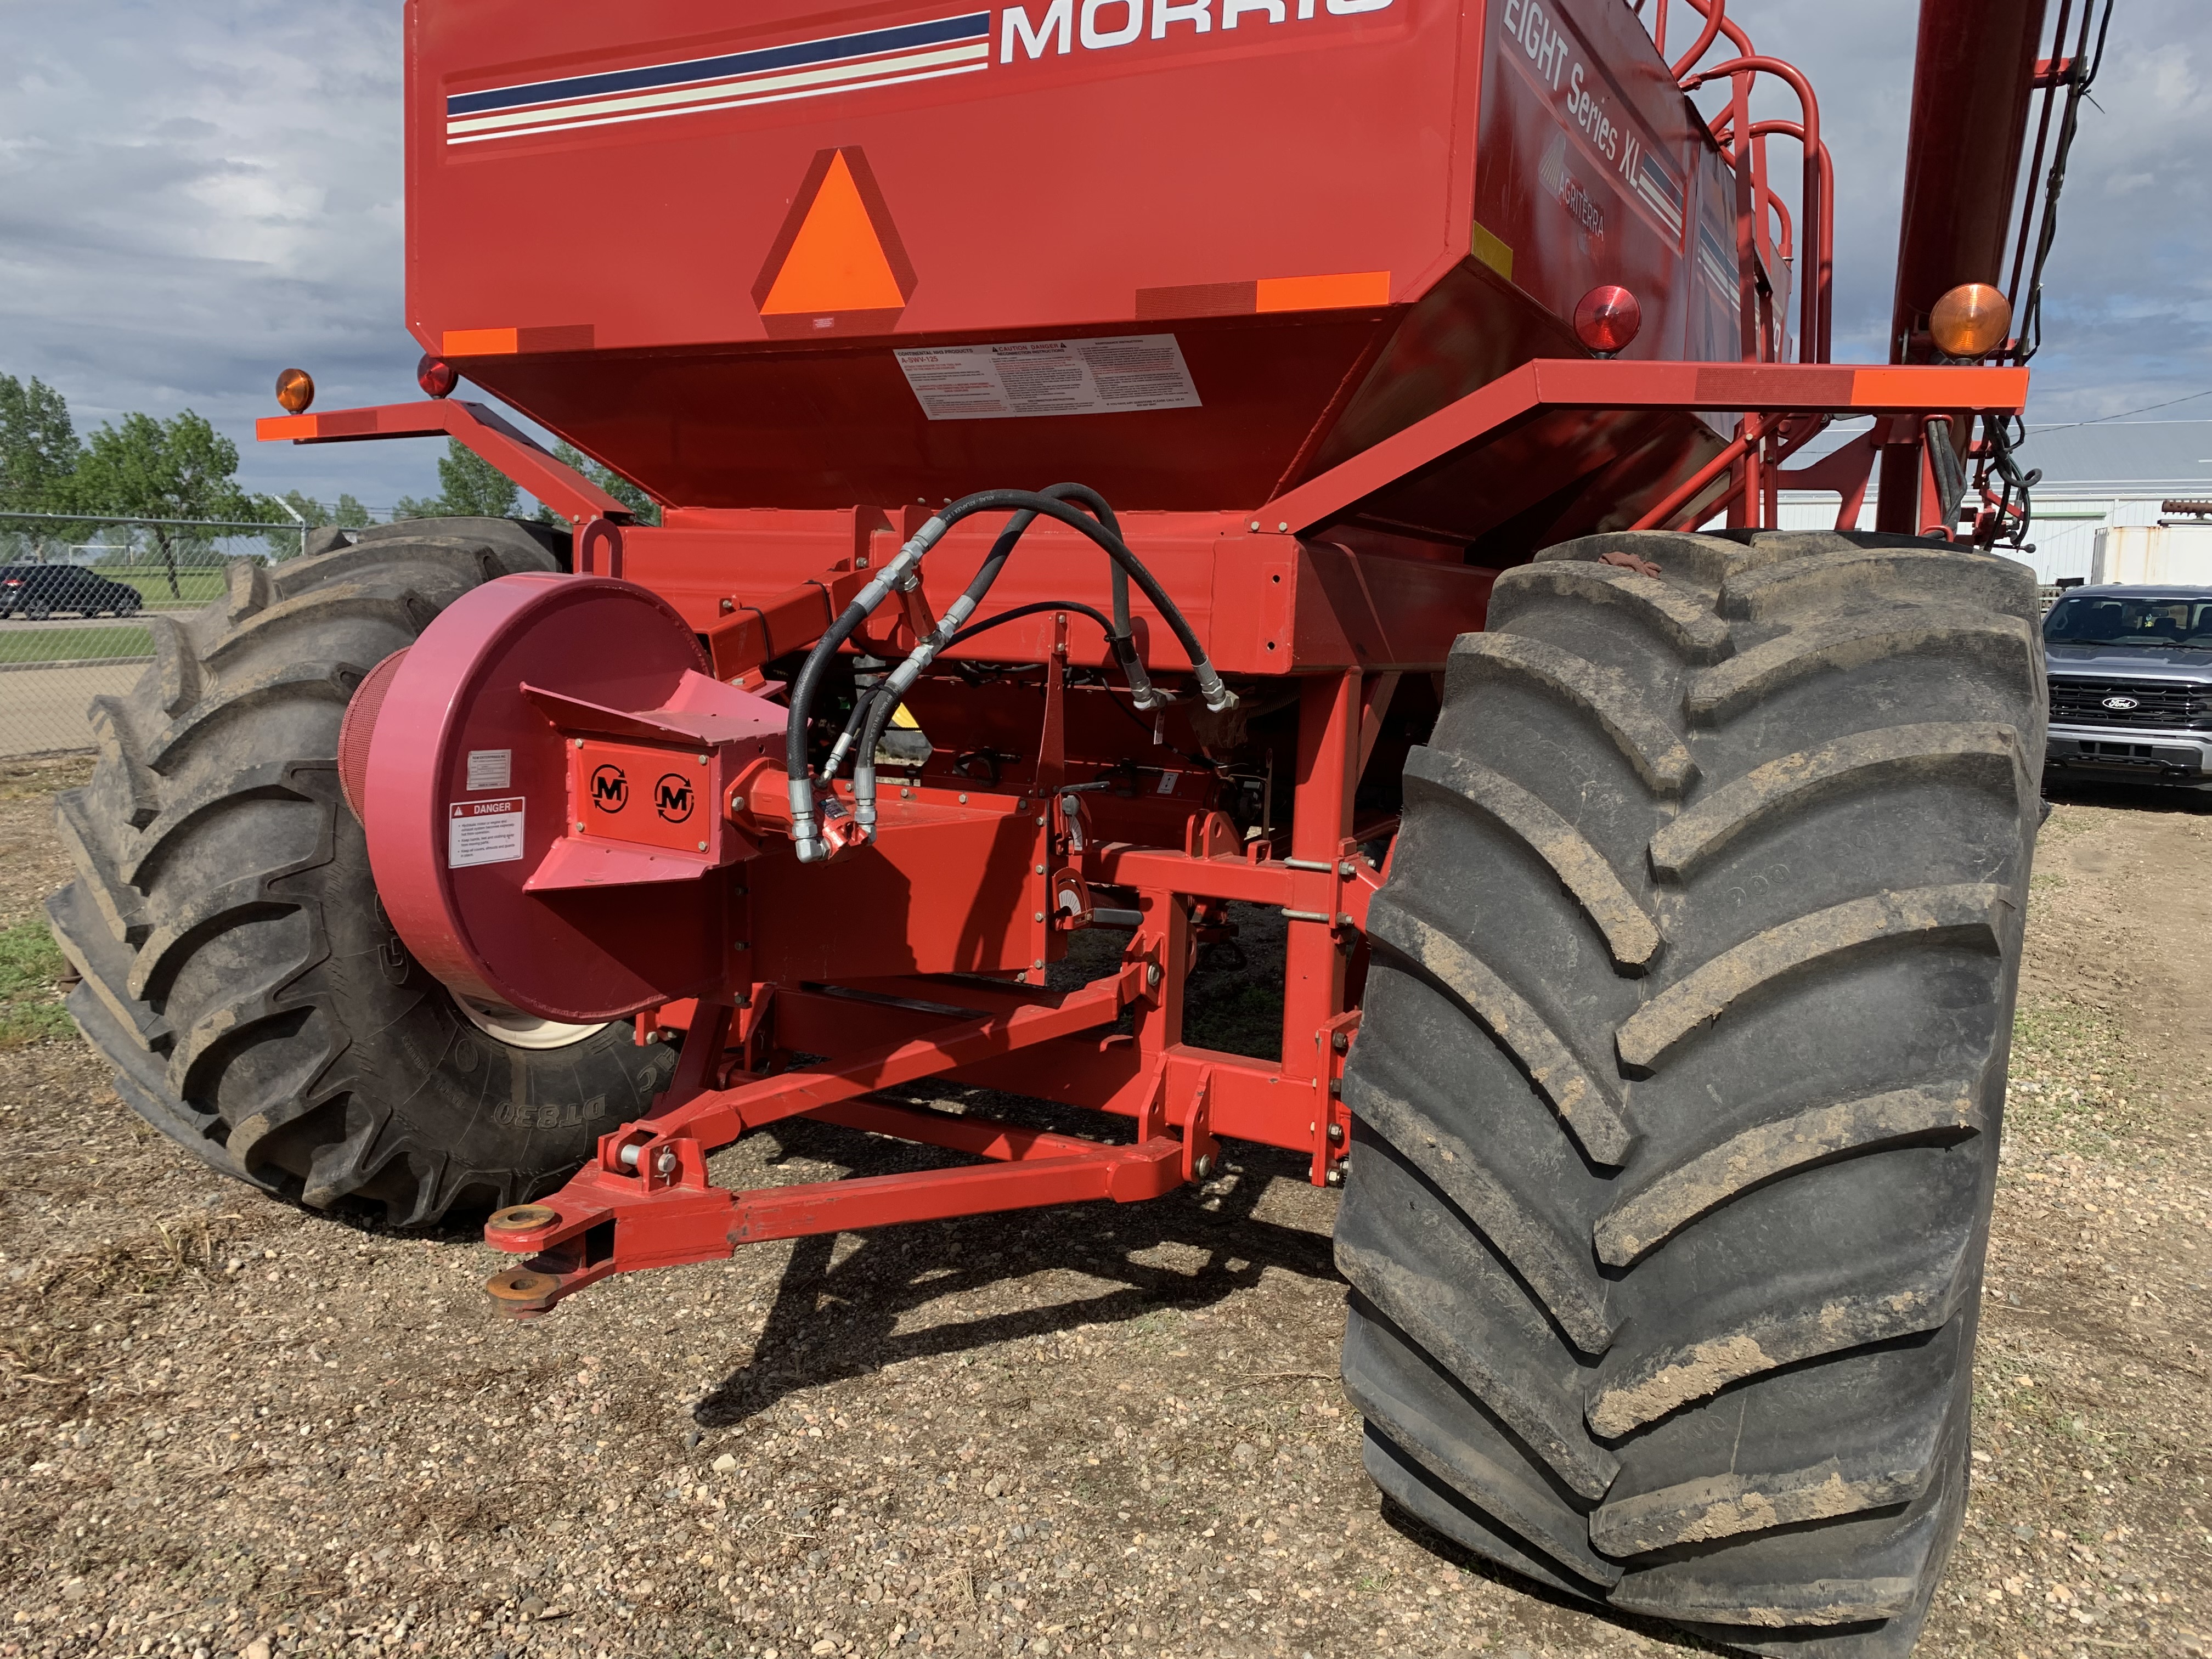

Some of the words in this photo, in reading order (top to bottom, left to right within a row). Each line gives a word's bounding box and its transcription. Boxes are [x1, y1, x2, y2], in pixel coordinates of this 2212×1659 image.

[1000, 0, 1392, 64] MORR
[1503, 0, 1568, 92] EIGHT
[1567, 62, 1618, 161] Series
[1618, 128, 1640, 189] XL
[877, 701, 888, 716] MADE
[2108, 698, 2130, 708] Ford
[874, 716, 881, 725] IN
[473, 802, 510, 814] DANGER
[494, 1094, 606, 1130] DT830
